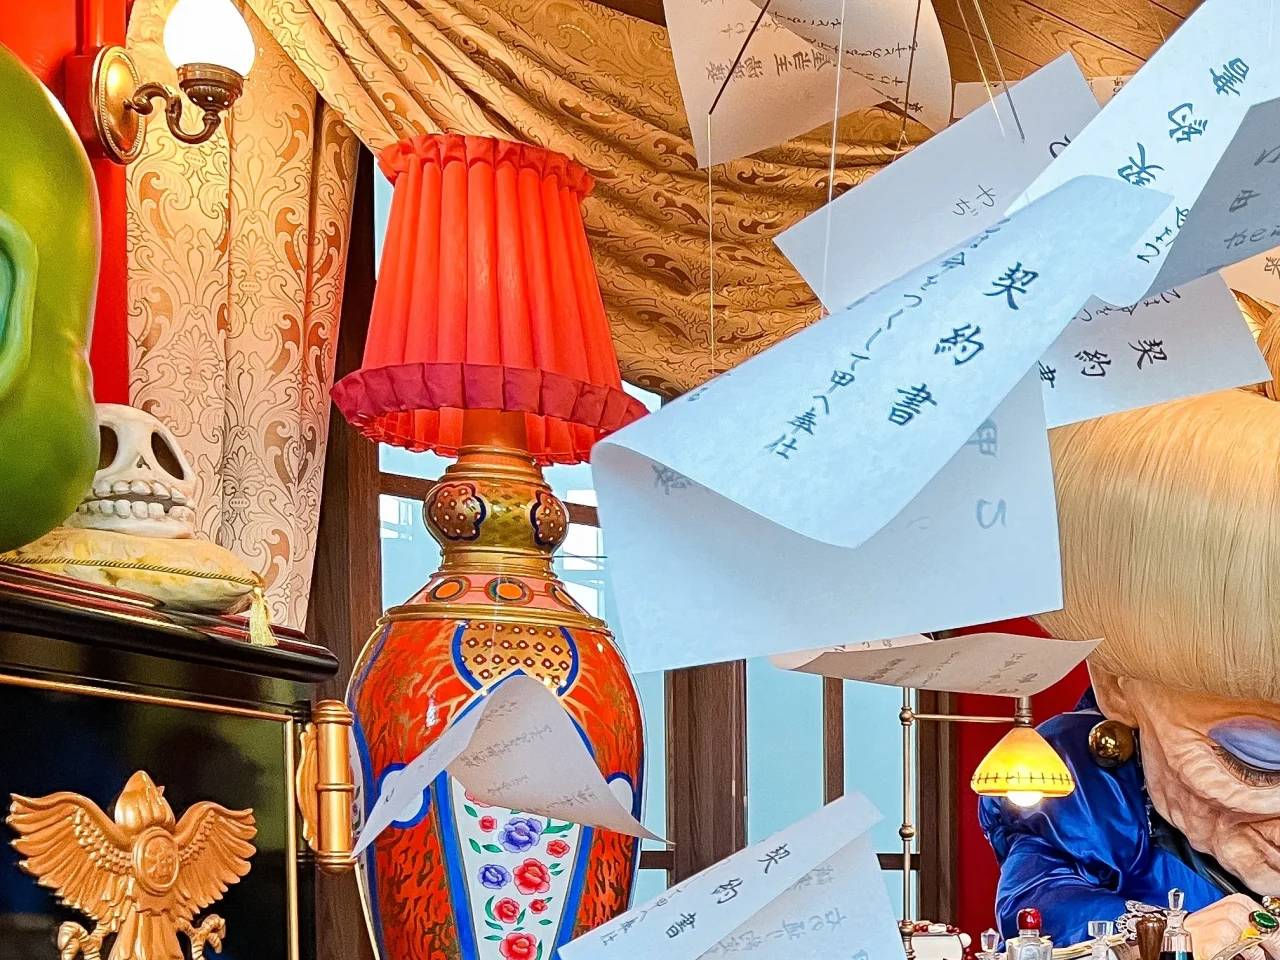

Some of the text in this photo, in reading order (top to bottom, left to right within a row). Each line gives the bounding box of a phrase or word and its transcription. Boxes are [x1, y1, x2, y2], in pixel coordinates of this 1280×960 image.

[887, 260, 1040, 427] 契約書
[664, 842, 792, 940] 契約書
